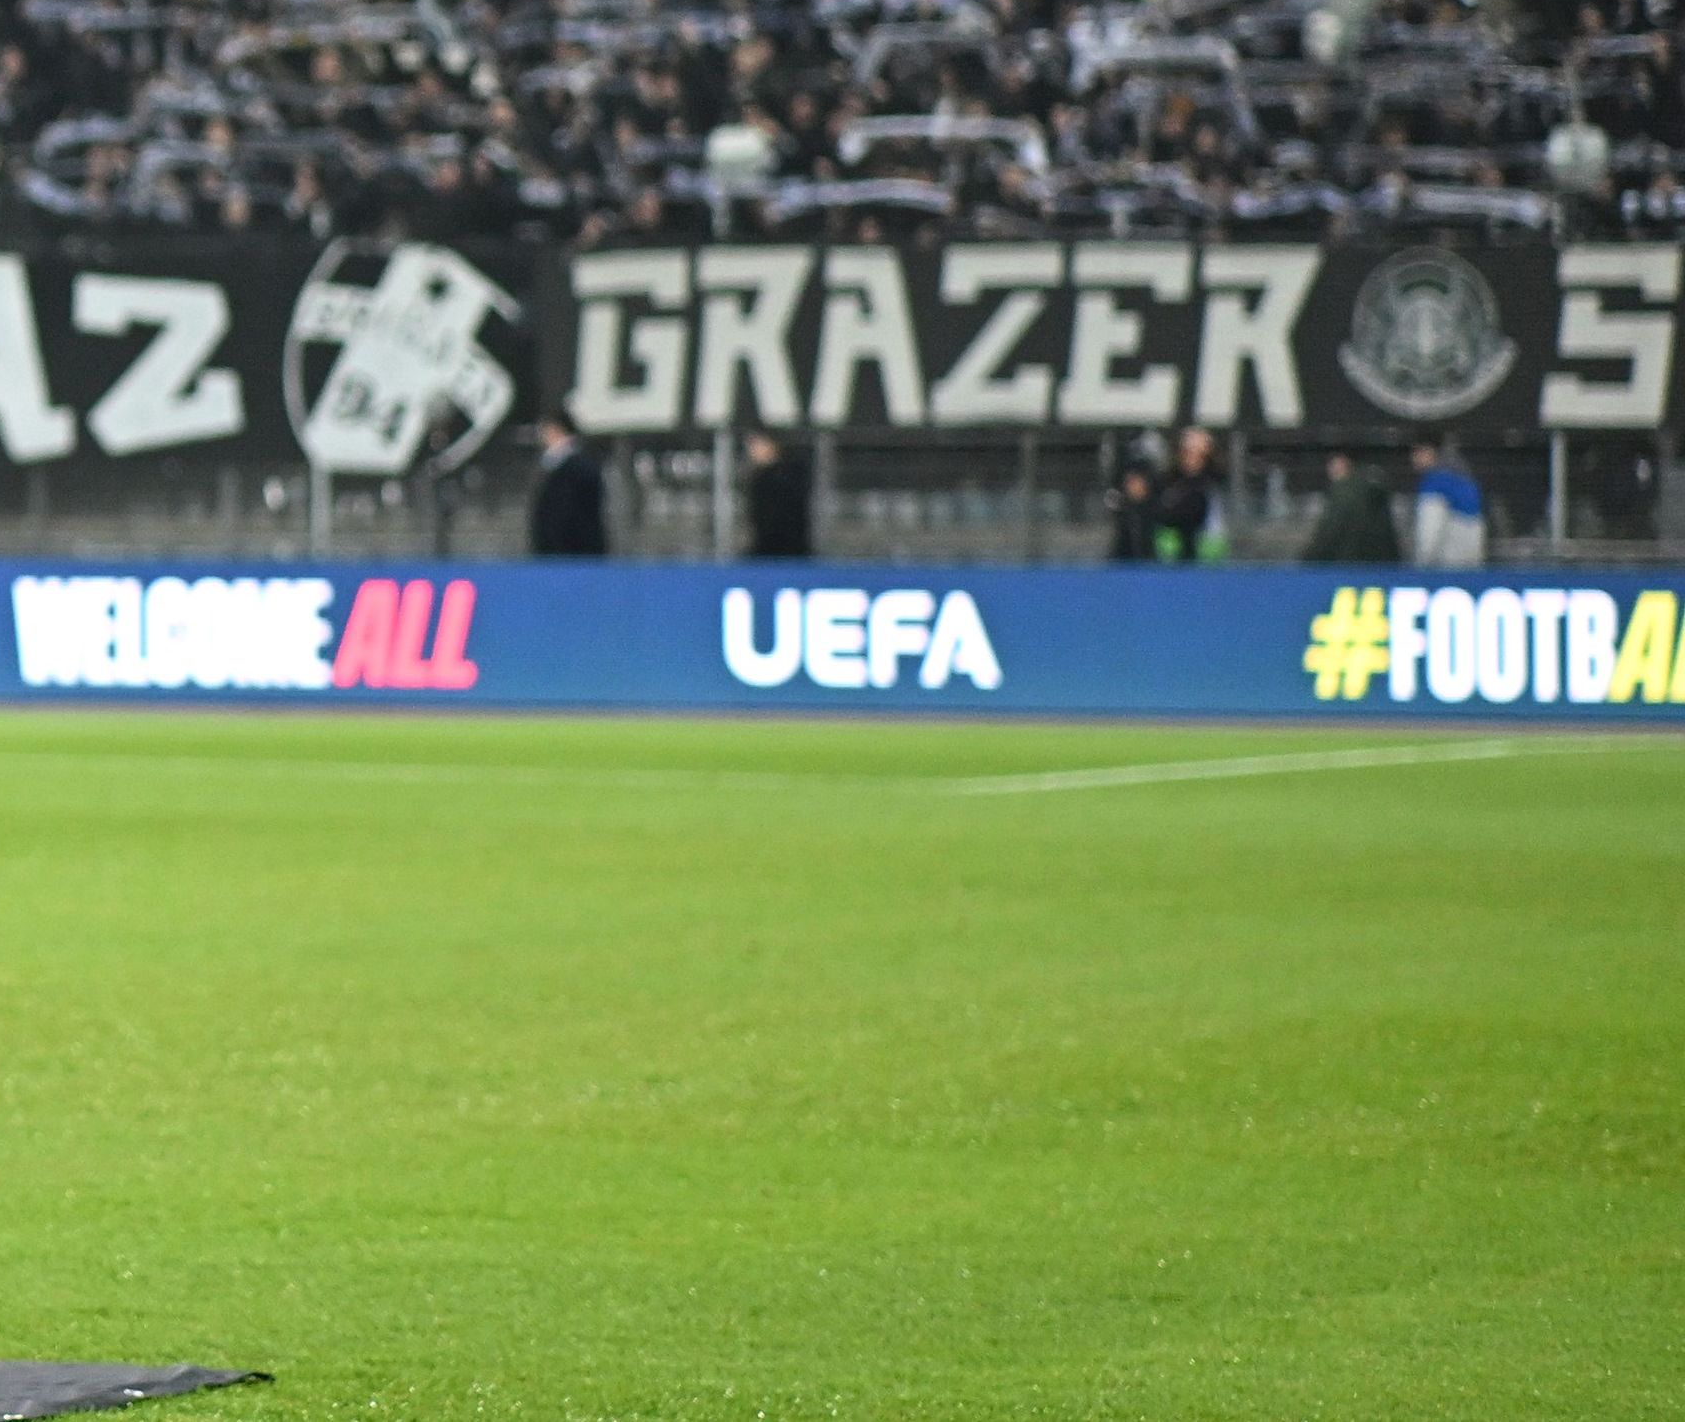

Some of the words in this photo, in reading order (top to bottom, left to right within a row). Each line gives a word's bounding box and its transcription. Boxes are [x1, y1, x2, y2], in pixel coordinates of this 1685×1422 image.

[569, 242, 1325, 430] GRAZER
[722, 587, 1003, 692] UEFA
[1304, 586, 1685, 705] #FOOTBA
